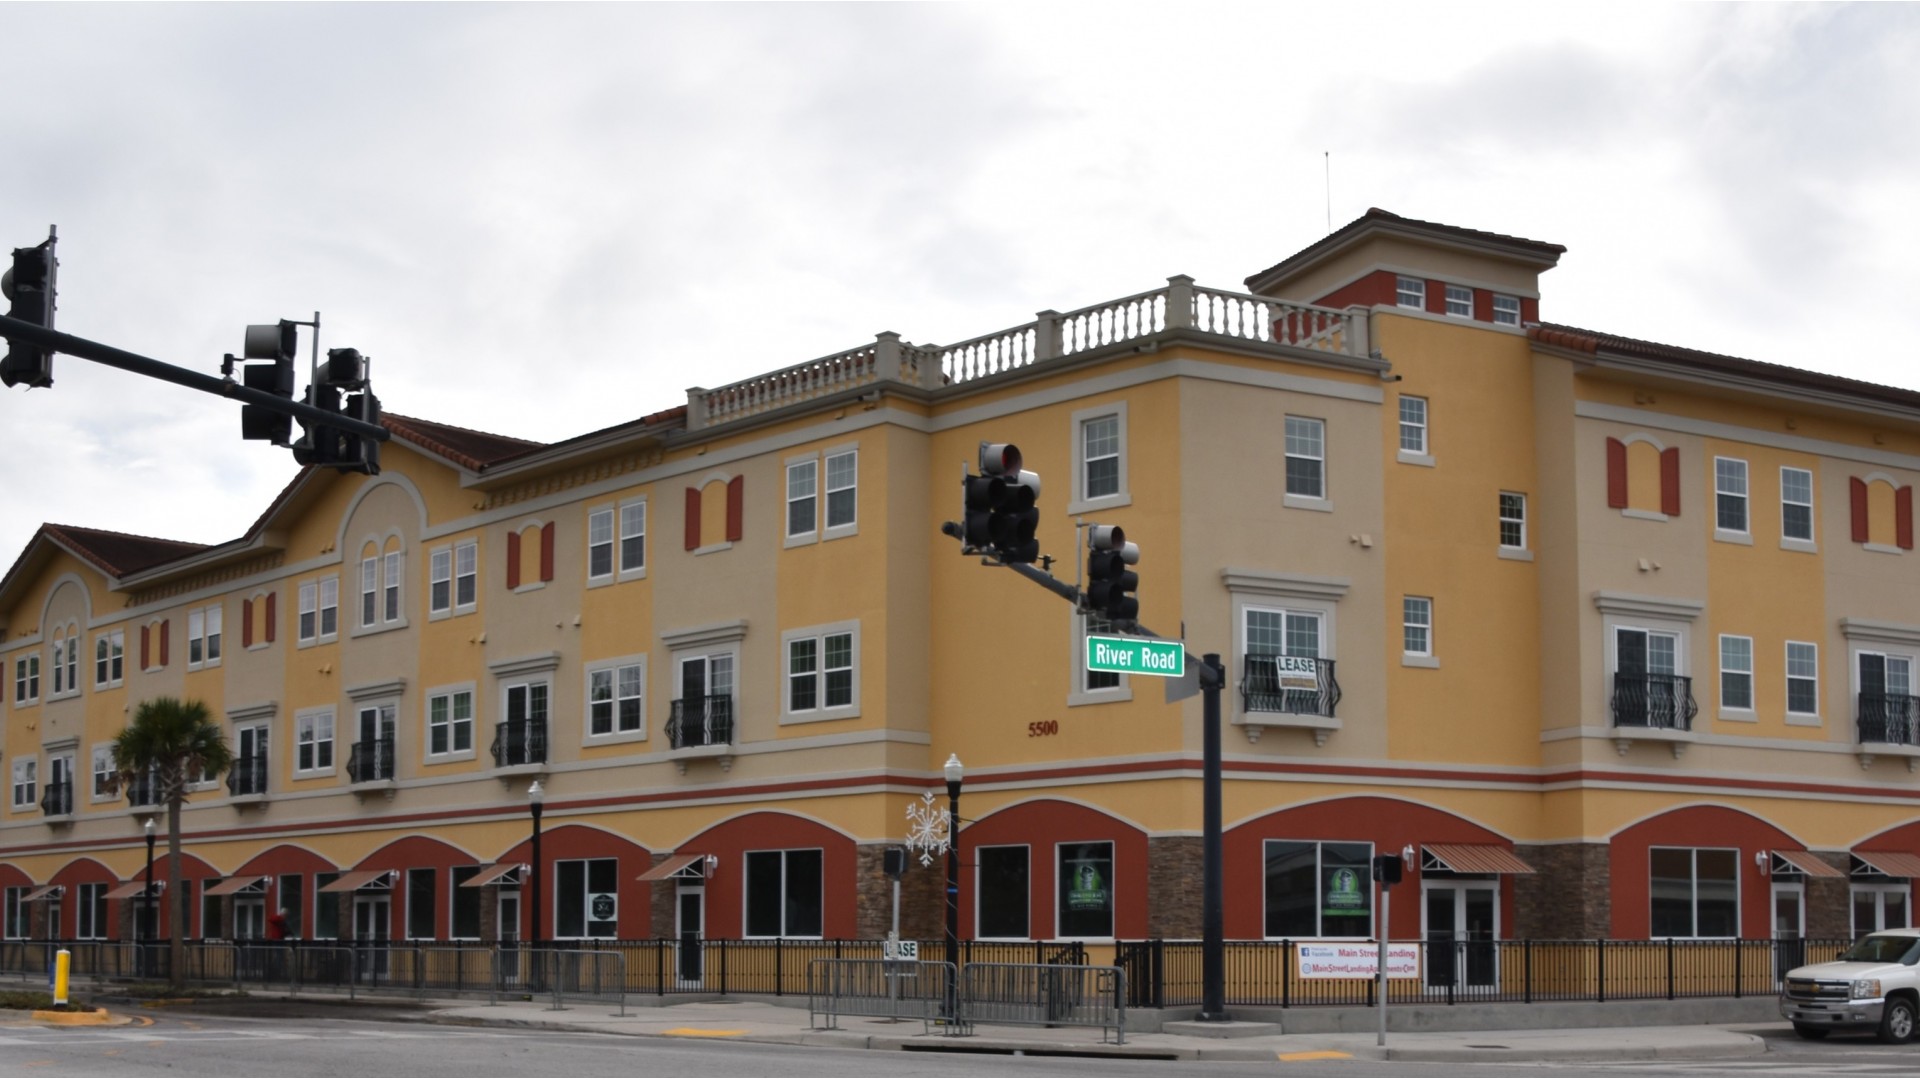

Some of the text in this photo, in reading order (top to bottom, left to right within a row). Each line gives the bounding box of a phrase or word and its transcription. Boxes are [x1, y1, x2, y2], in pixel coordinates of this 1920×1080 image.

[1096, 643, 1176, 670] River Road
[1278, 658, 1315, 673] LEASE
[1028, 720, 1059, 738] 5500
[885, 942, 916, 957] LASE
[1338, 949, 1357, 958] Main
